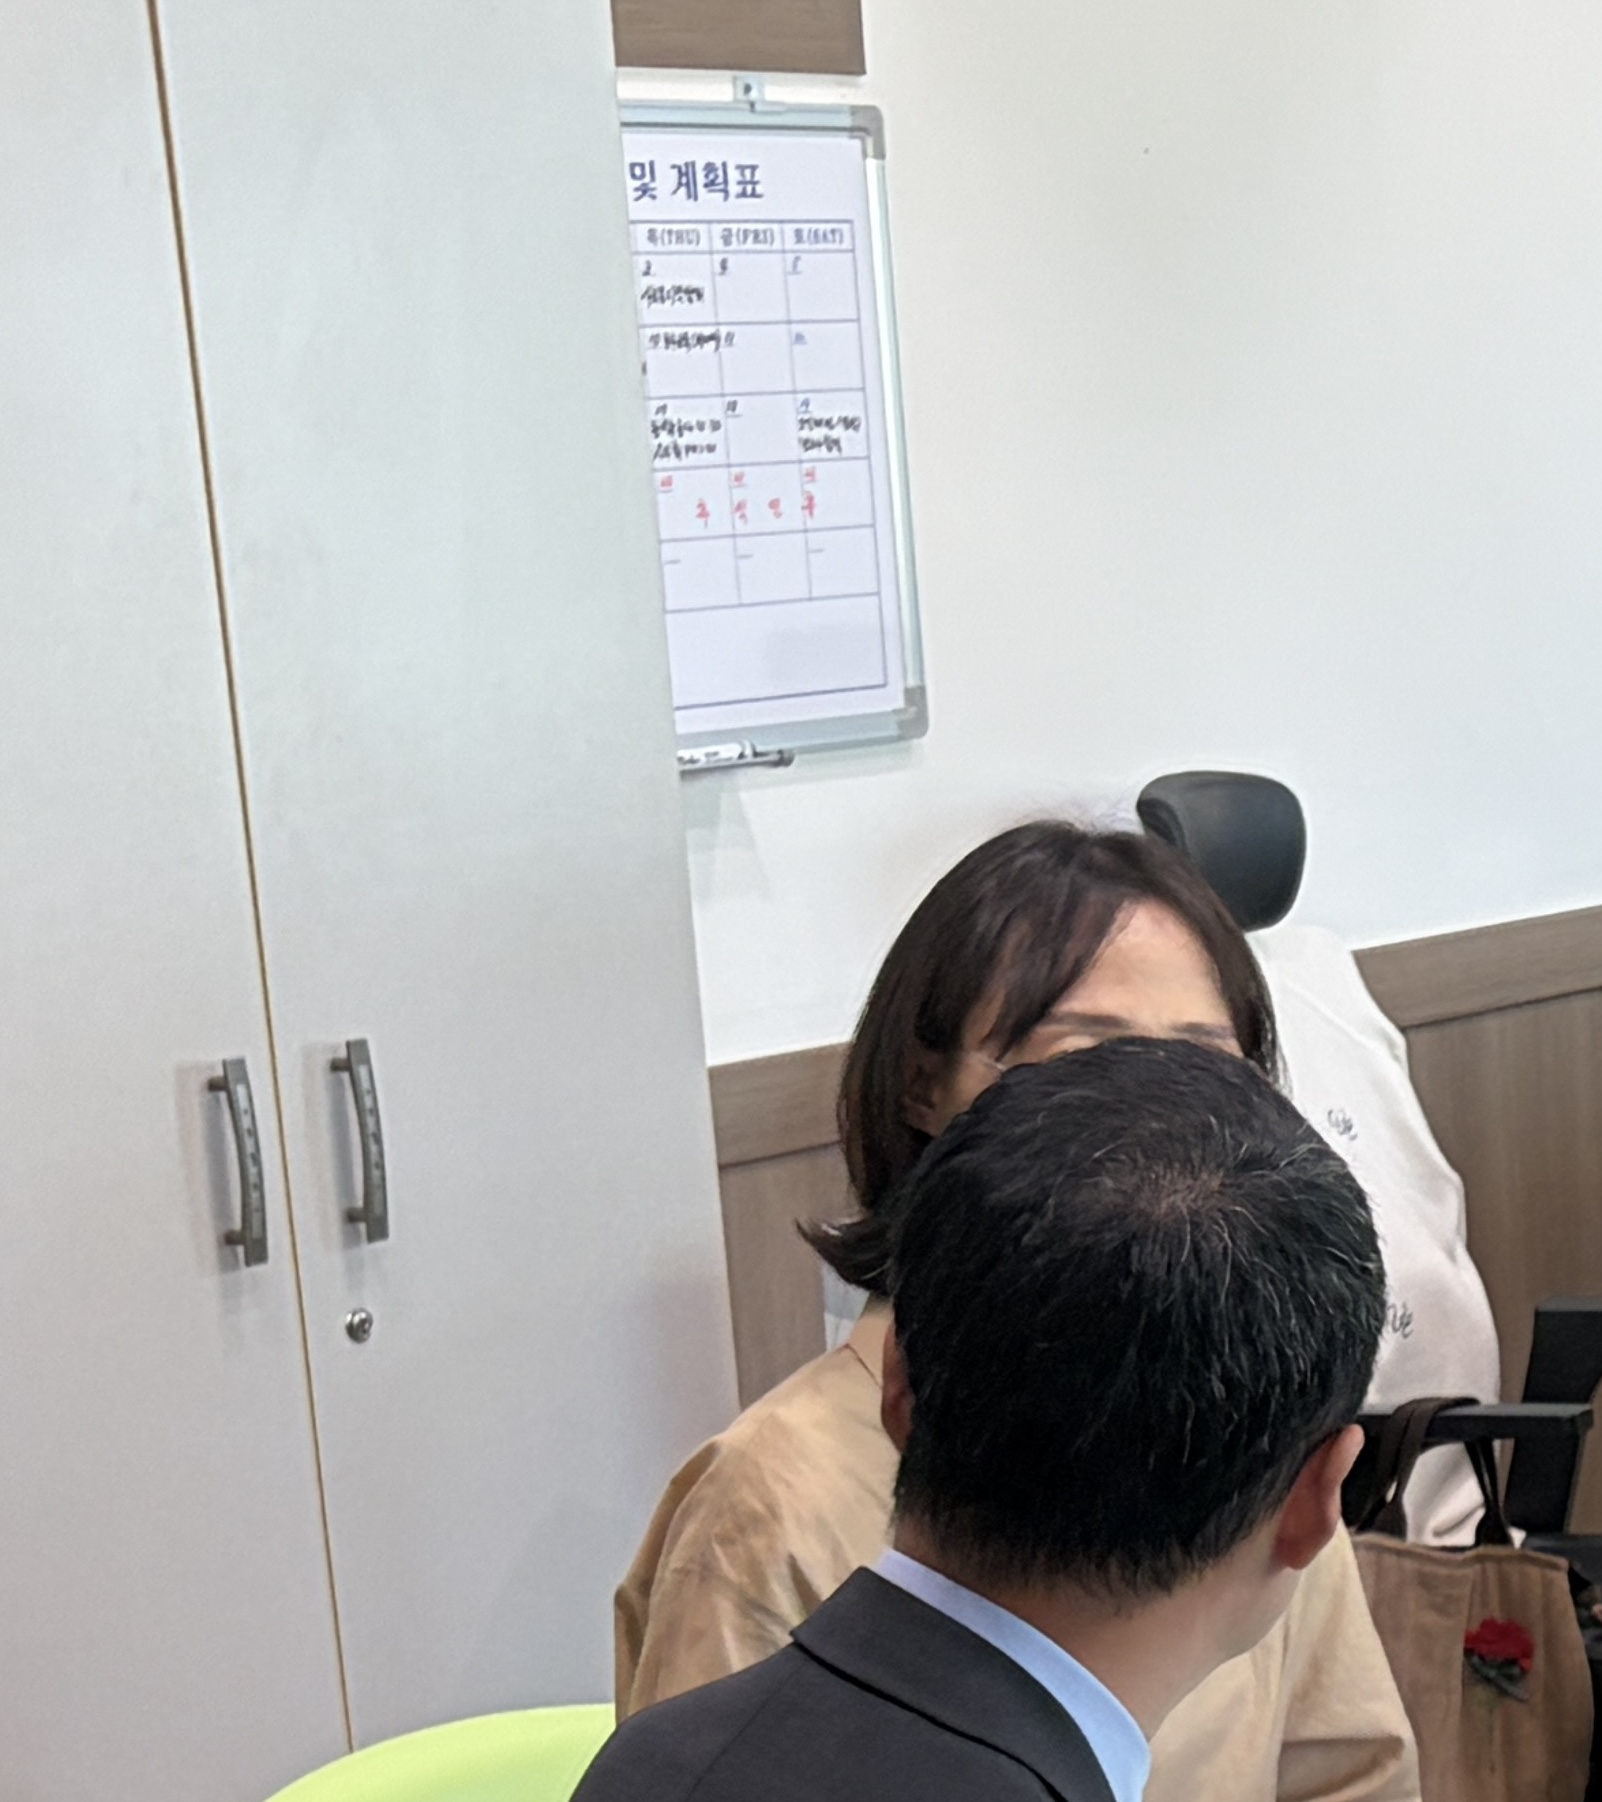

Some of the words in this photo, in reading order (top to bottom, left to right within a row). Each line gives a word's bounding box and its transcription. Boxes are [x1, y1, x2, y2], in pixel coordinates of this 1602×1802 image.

[629, 160, 657, 202] 및
[670, 160, 764, 202] 계획표
[646, 228, 700, 247] 목(THU)
[719, 227, 775, 247] 금(FRI)
[793, 227, 844, 246] 토(SAT)
